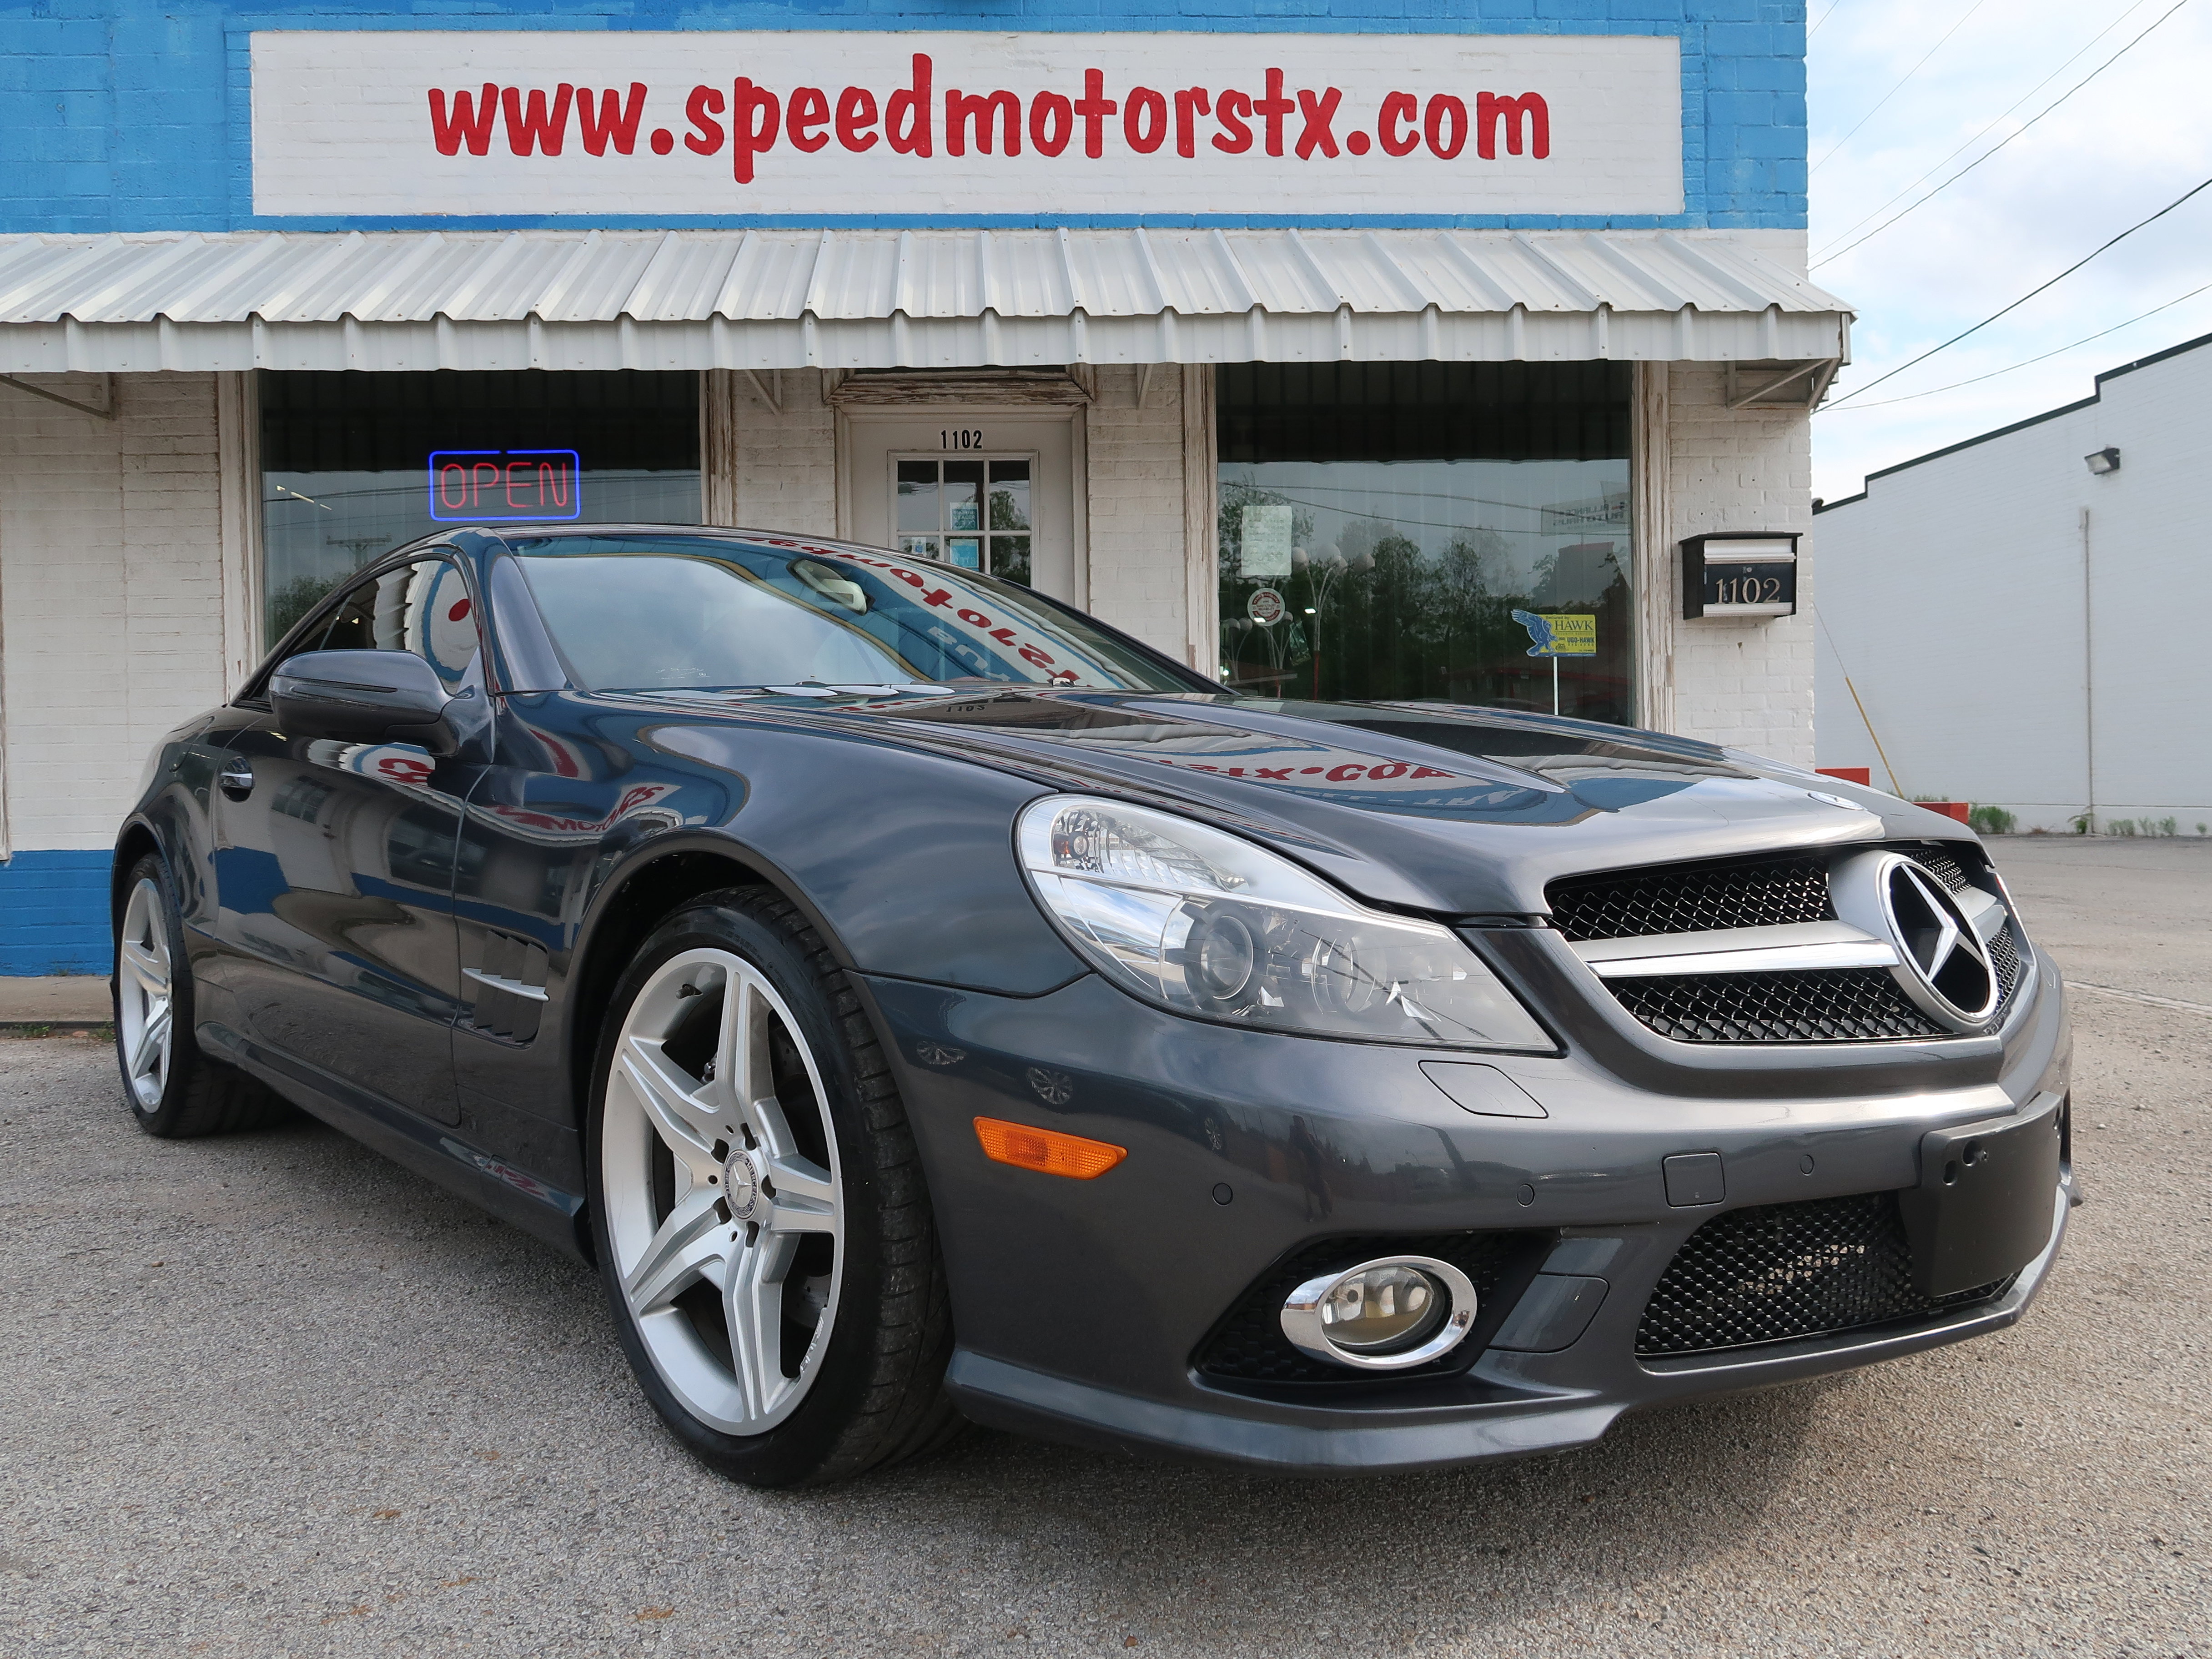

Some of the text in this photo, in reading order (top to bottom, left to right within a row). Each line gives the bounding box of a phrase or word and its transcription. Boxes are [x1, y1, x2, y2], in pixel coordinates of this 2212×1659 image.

[428, 53, 1550, 184] www.speedmotorstx.com
[941, 430, 982, 449] 1102
[440, 462, 568, 508] OPEN
[1715, 578, 1780, 604] 1102
[1554, 620, 1594, 631] HAWK
